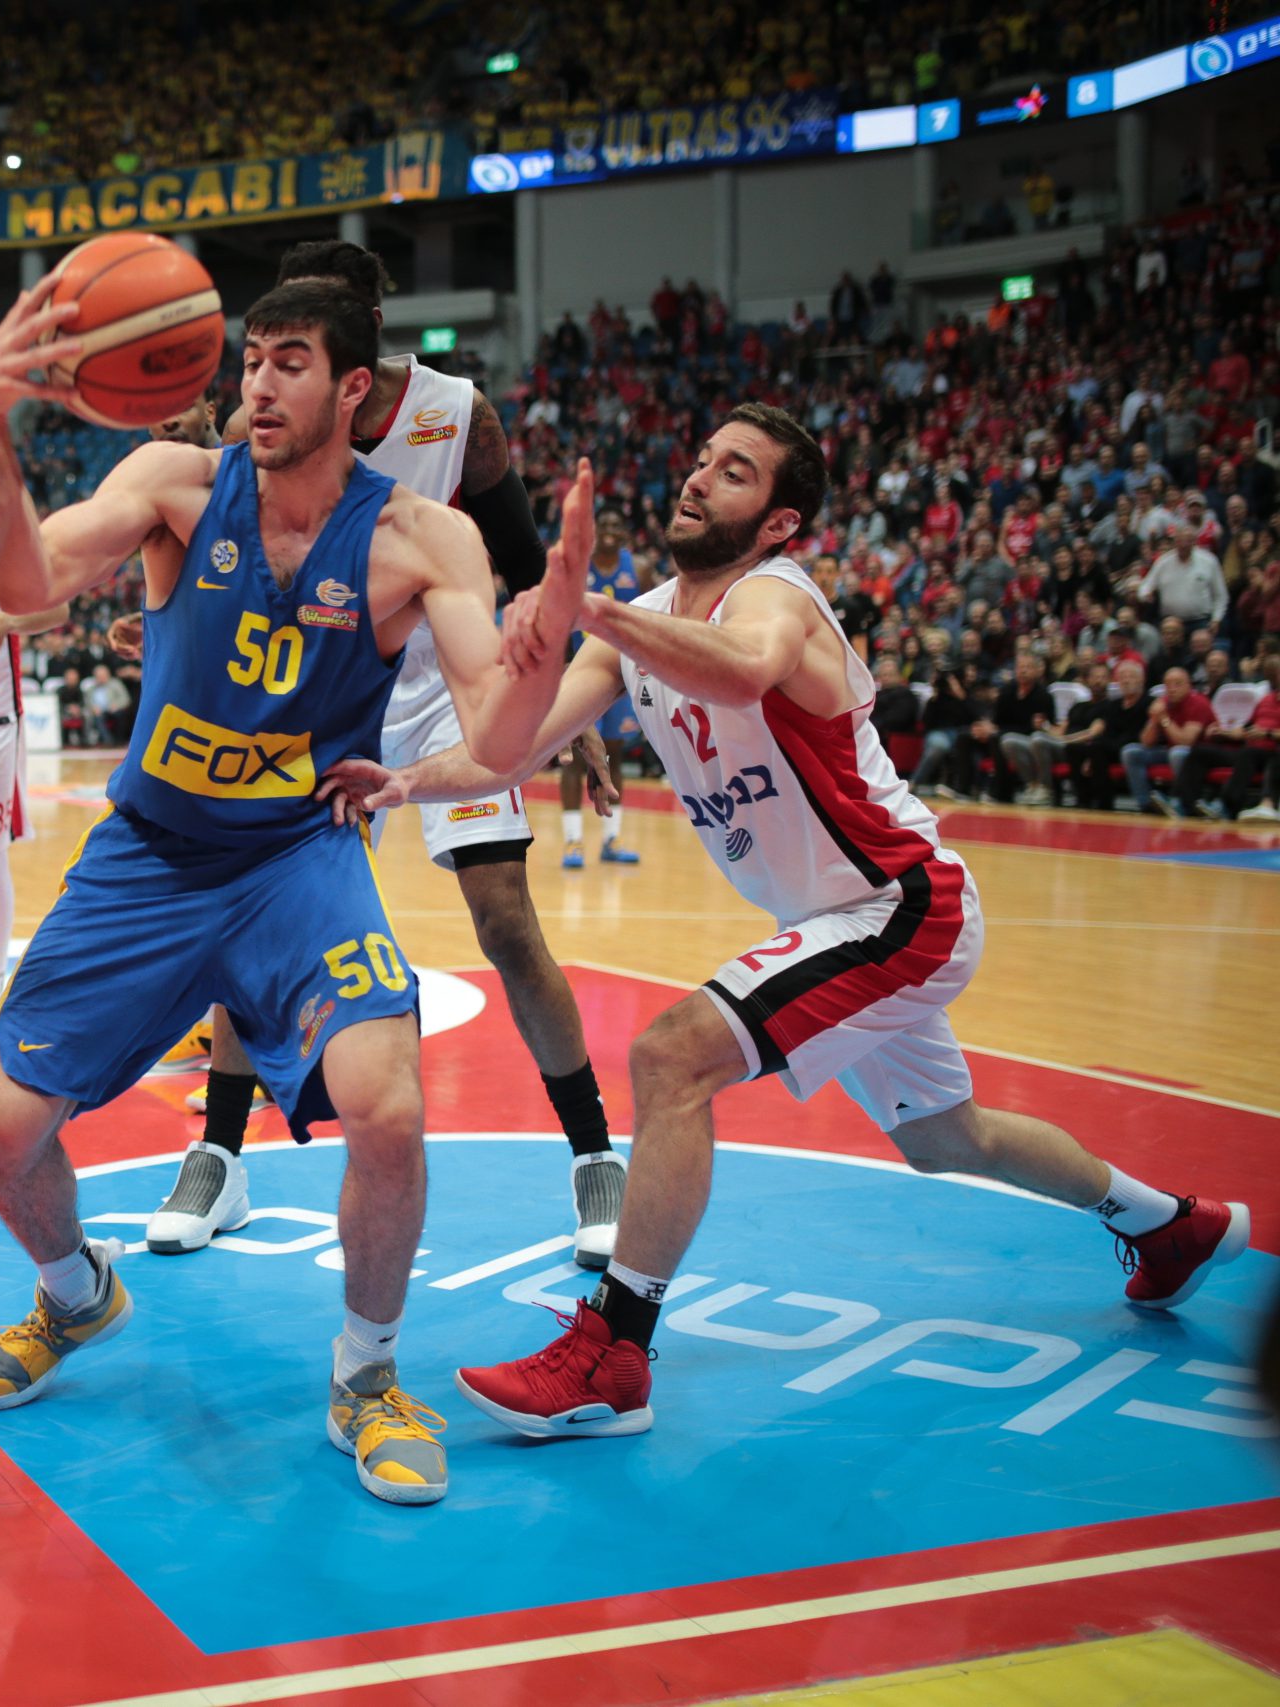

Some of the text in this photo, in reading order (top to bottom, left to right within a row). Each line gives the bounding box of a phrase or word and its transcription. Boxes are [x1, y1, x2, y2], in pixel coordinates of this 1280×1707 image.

[930, 106, 950, 132] 7
[1077, 80, 1097, 105] 8
[602, 104, 740, 169] ULTRAS
[7, 160, 298, 239] MACCABI
[305, 610, 347, 625] Winner
[227, 610, 304, 695] 50
[160, 727, 300, 785] FOX
[671, 703, 718, 763] 12
[453, 808, 486, 820] Winner
[322, 932, 409, 999] 50
